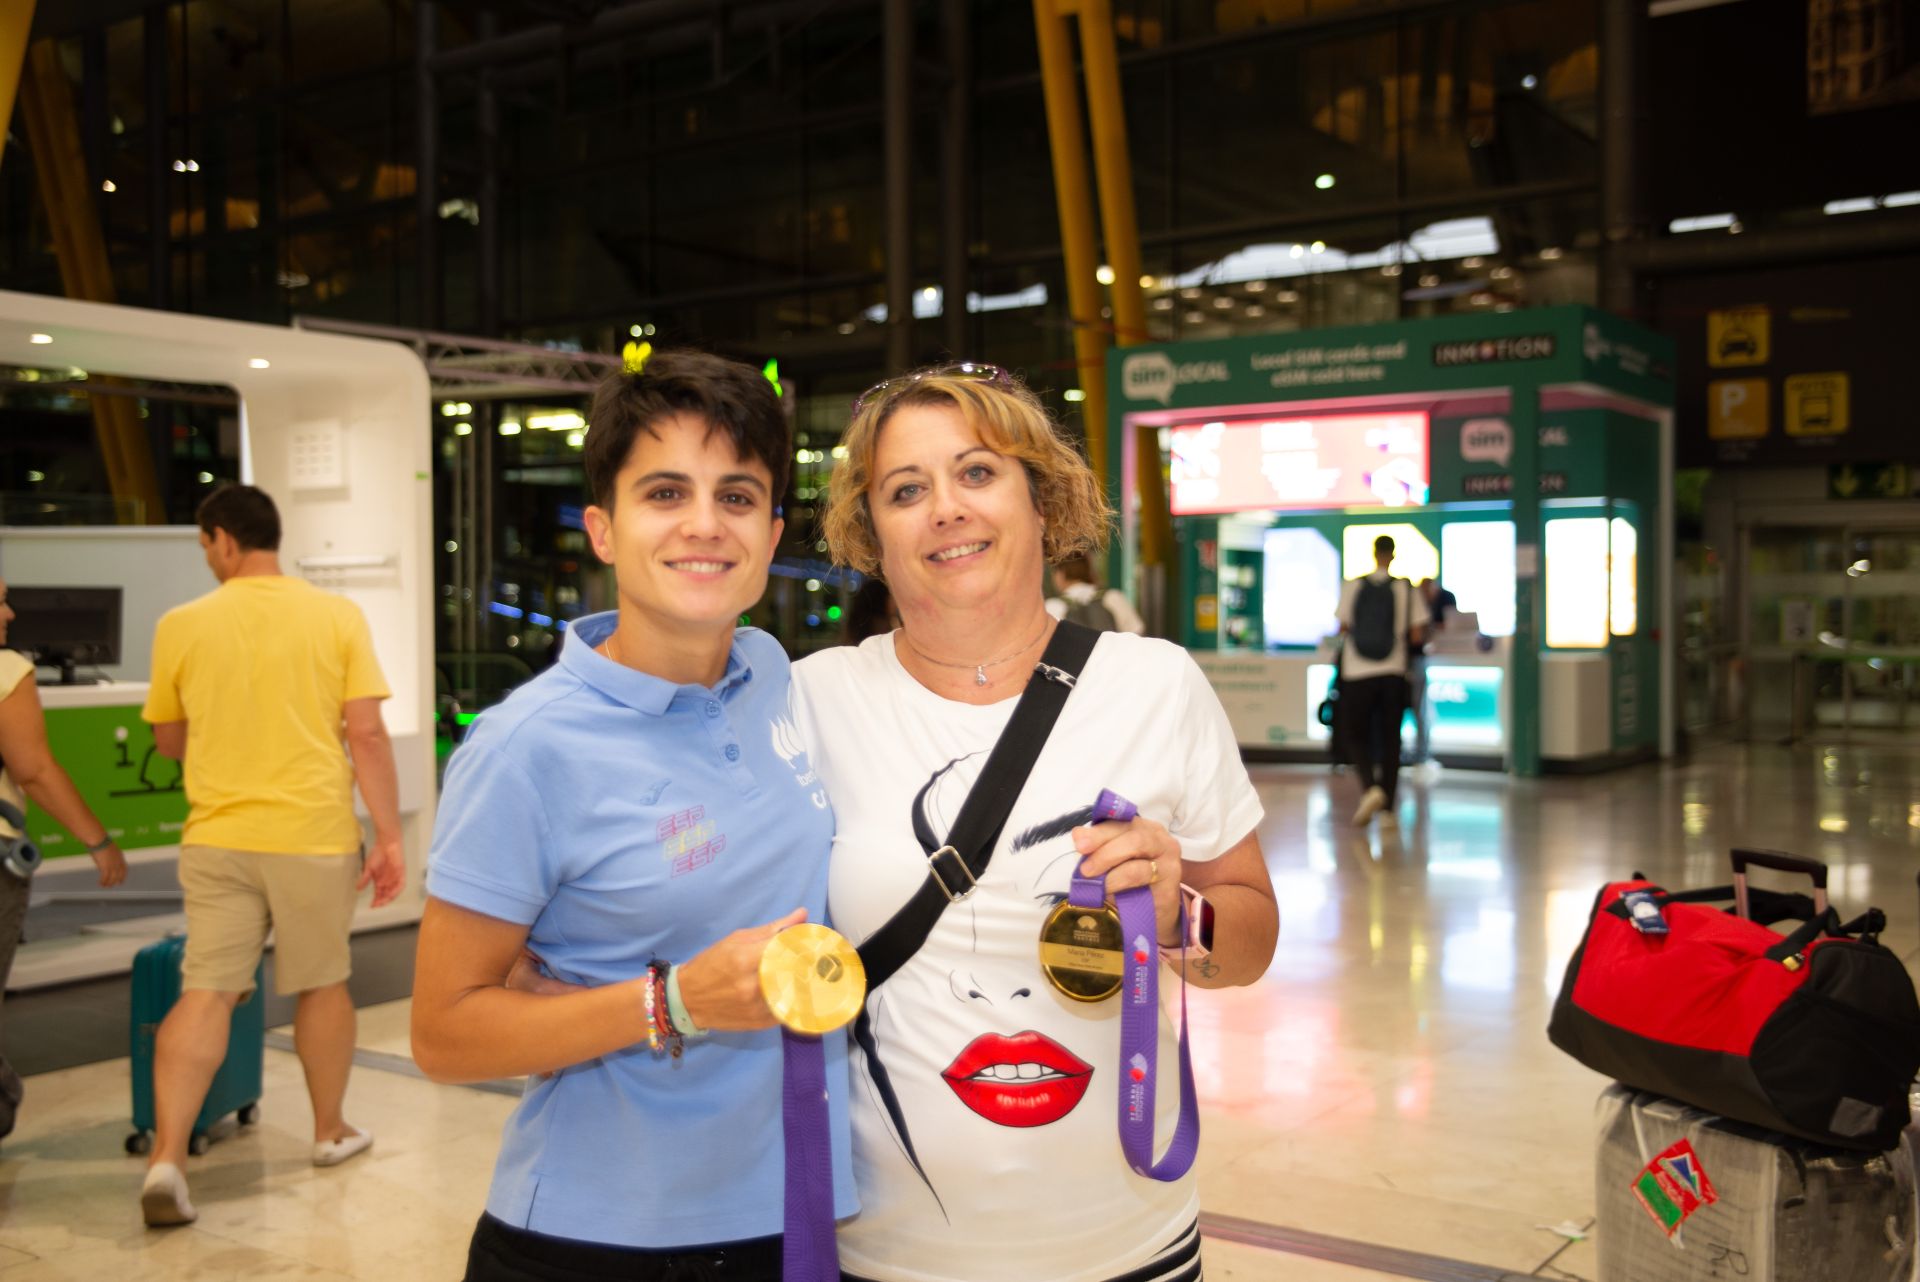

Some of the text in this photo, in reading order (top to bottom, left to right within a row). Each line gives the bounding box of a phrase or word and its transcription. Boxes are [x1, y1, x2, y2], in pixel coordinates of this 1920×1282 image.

[1251, 340, 1407, 370] Local SIM cards and
[1436, 337, 1552, 363] INMOTION
[1132, 363, 1166, 384] sim
[1312, 367, 1344, 384] sold
[1346, 365, 1385, 382] here
[1721, 384, 1747, 418] P
[656, 804, 705, 844] ESP
[671, 833, 727, 880] ESP
